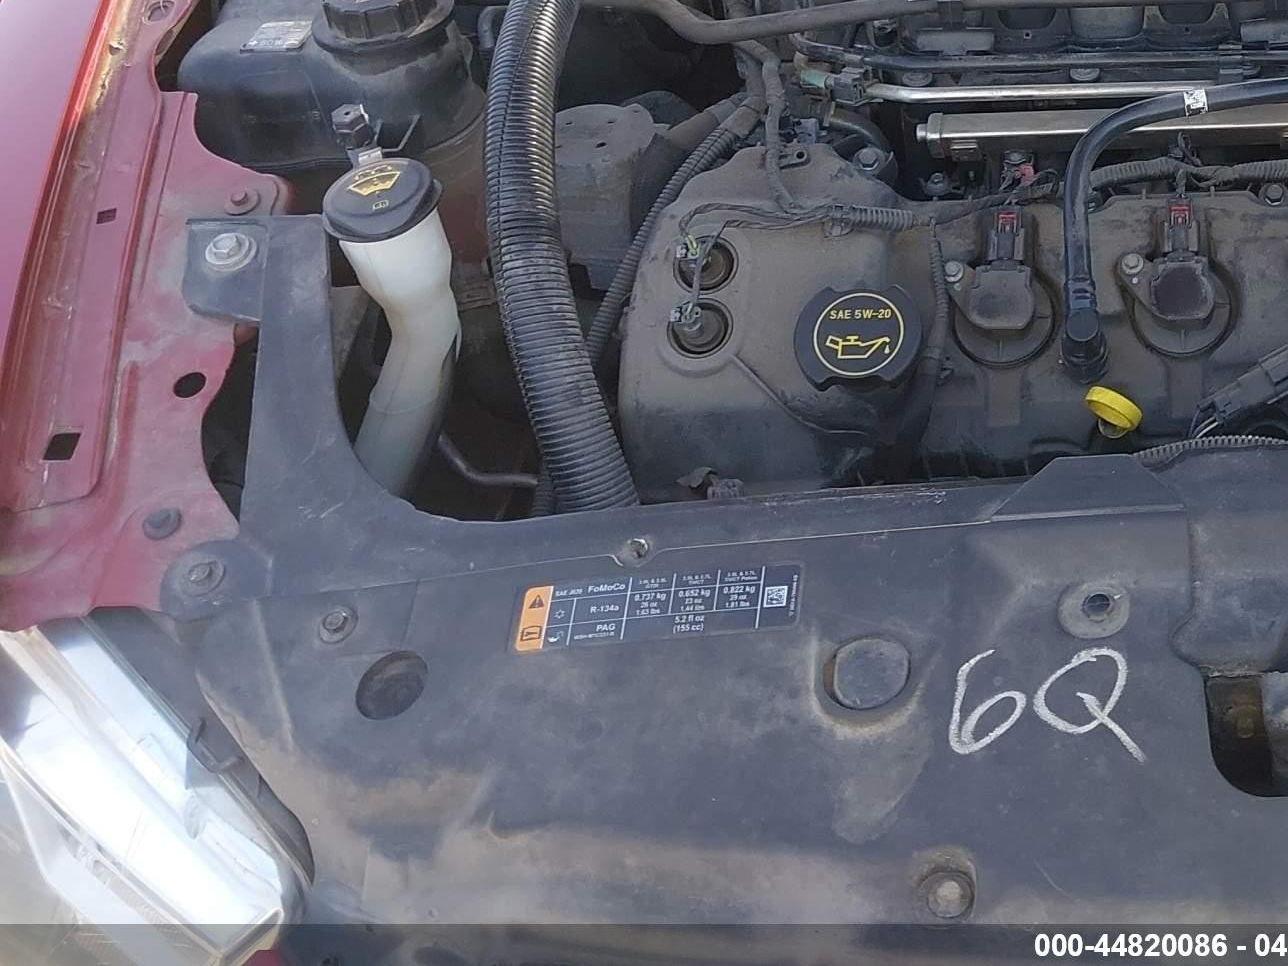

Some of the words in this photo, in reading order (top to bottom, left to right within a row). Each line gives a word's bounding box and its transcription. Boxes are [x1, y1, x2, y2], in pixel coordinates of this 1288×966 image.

[829, 309, 852, 320] SAE
[854, 308, 892, 320] 5W-20
[588, 583, 625, 594] FoMoCo
[678, 589, 700, 598] 0.652
[700, 588, 711, 597] kg
[723, 585, 744, 594] 0.822
[745, 585, 756, 594] kg
[634, 592, 655, 602] 0.737
[656, 592, 667, 601] kg
[590, 604, 620, 613] R-134a
[674, 615, 687, 624] 5.2
[688, 614, 694, 622] fl
[596, 623, 616, 632] PAG
[673, 624, 690, 634] (155
[690, 622, 704, 632] cc)
